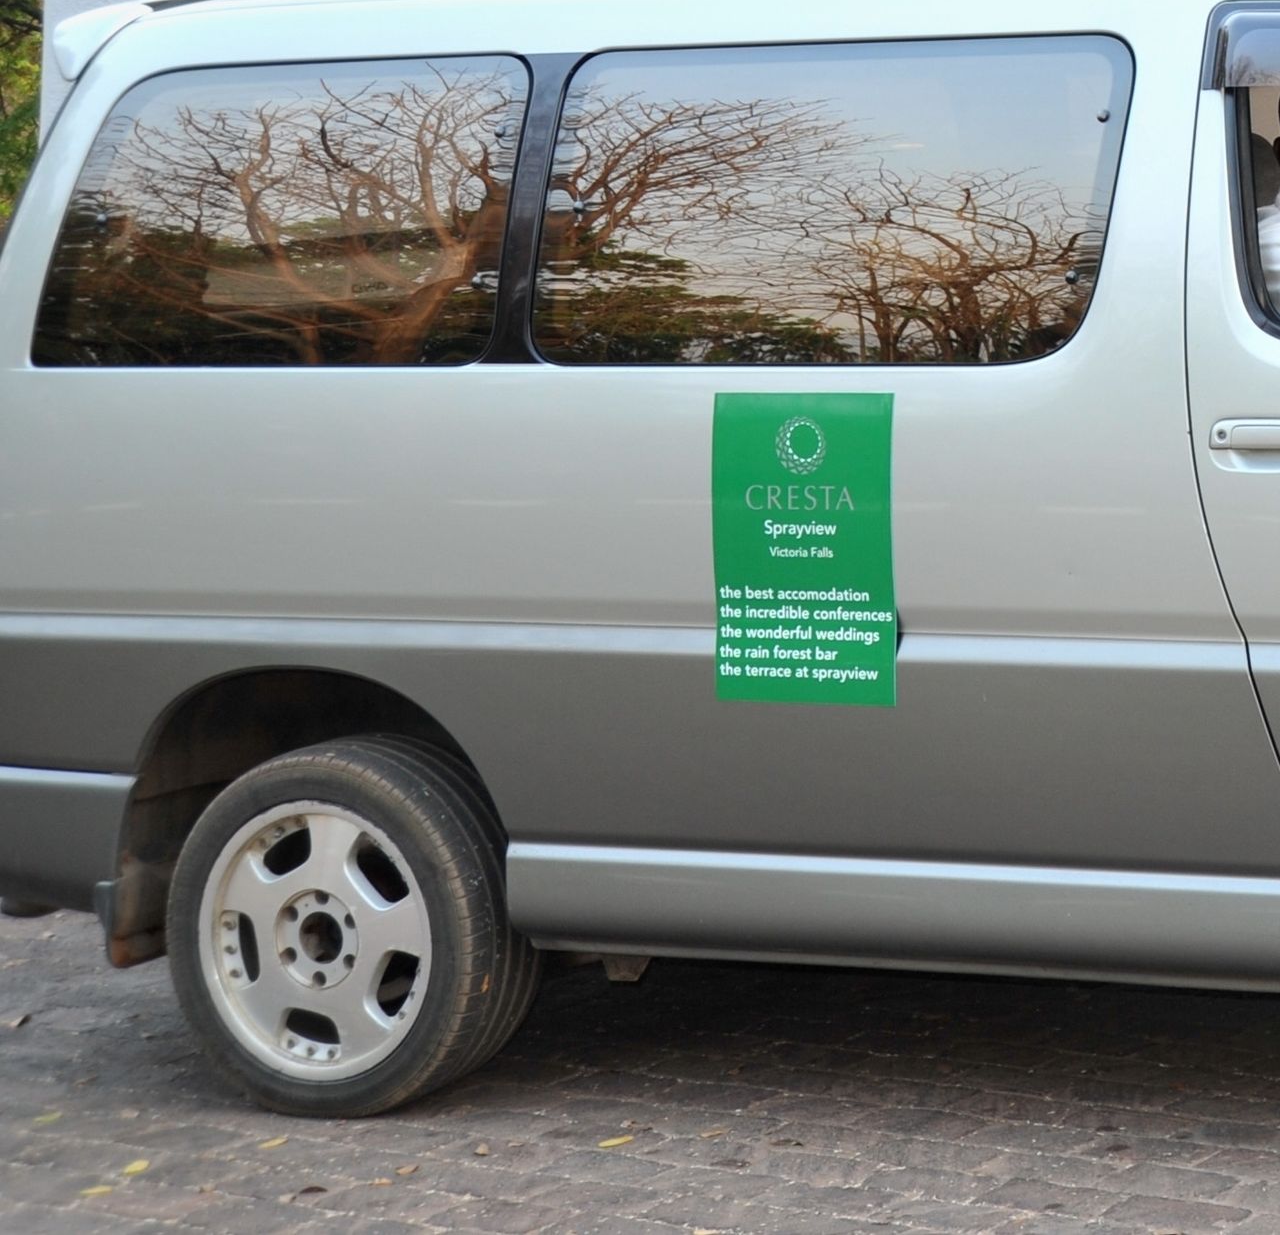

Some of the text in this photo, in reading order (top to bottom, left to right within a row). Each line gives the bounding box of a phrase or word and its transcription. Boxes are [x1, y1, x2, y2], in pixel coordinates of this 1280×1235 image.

[745, 485, 855, 510] CRESTA
[764, 520, 836, 539] Sprayview
[770, 546, 833, 558] Victoria Falls
[720, 585, 869, 602] the best accomodation
[720, 605, 892, 622] the incredible conferences
[721, 624, 880, 645] the wonderful weddings
[720, 644, 838, 660] the rain forest bar
[720, 664, 878, 683] the terrace at sprayview
